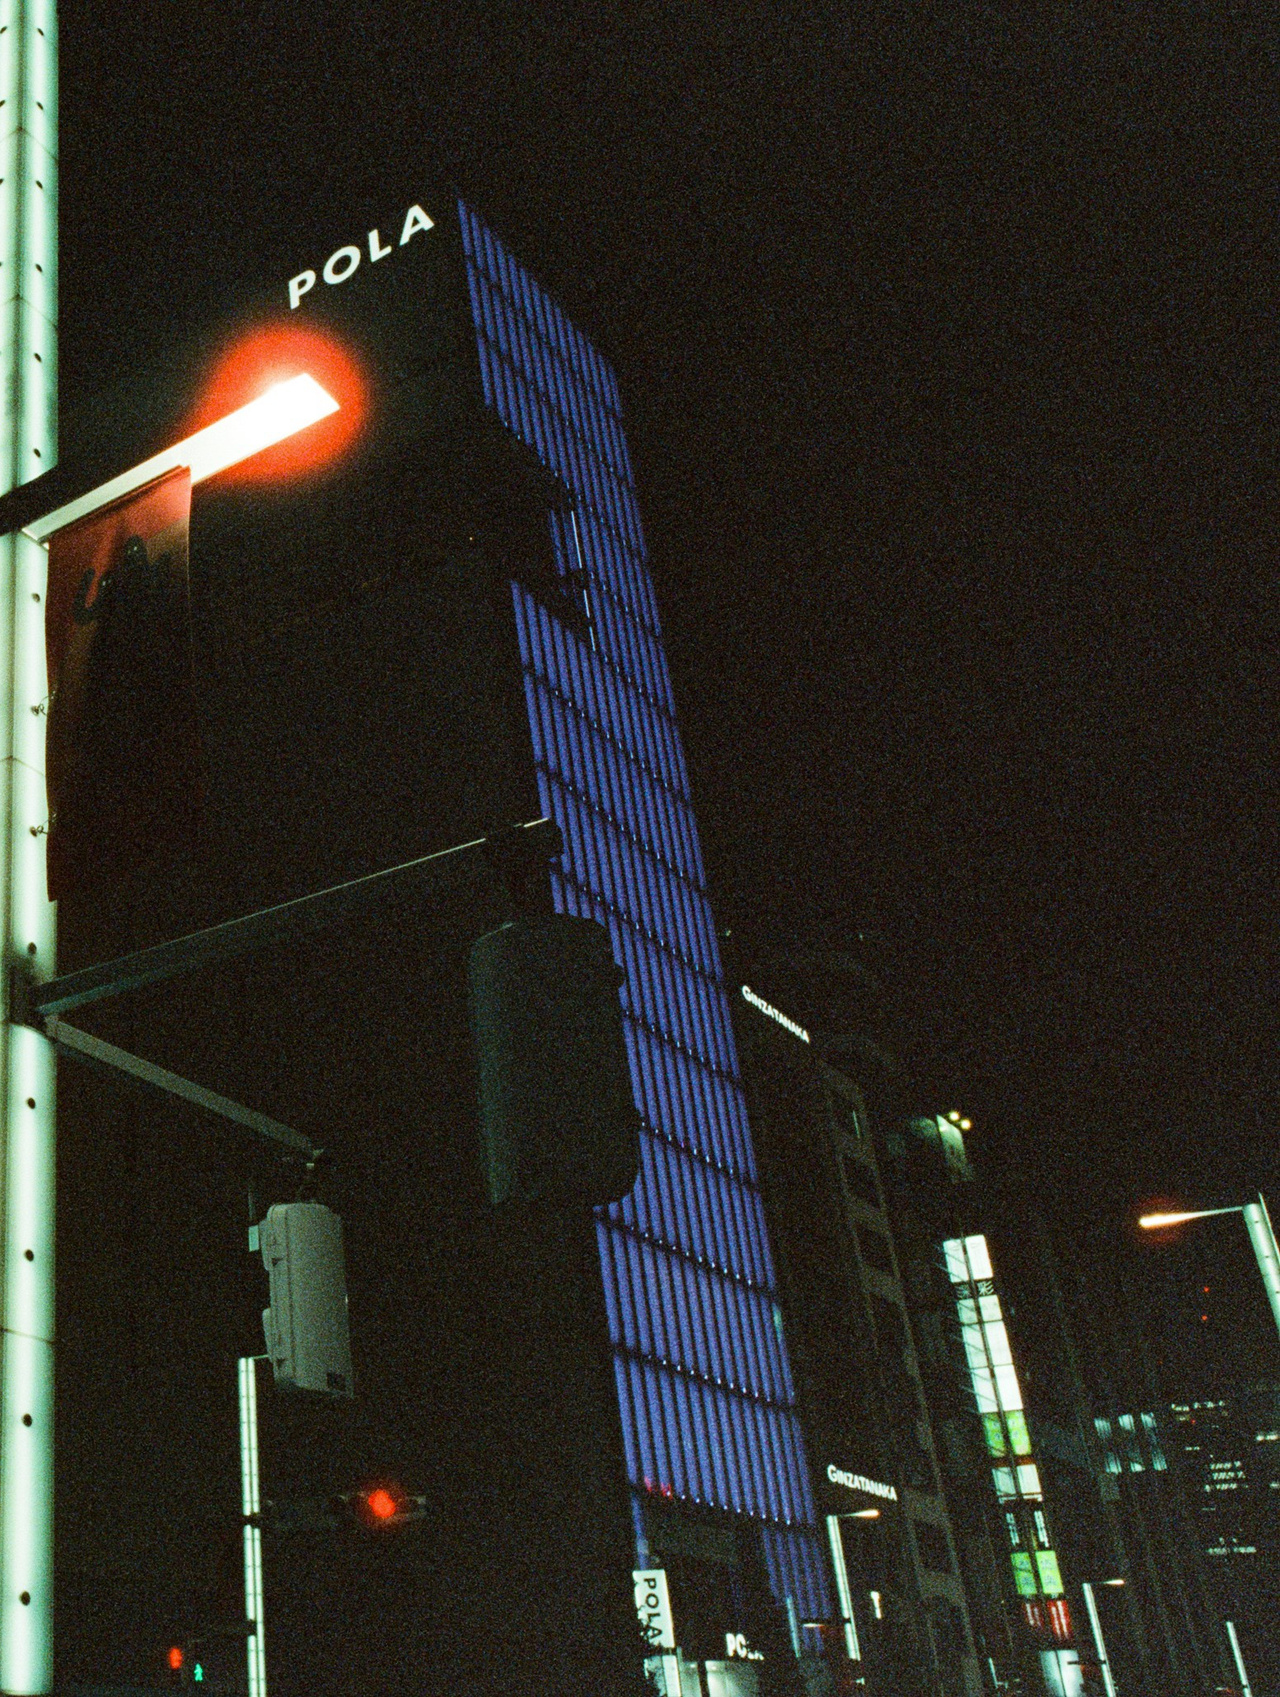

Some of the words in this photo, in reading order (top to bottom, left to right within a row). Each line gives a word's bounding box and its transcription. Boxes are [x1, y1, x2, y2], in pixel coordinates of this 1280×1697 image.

[288, 204, 435, 310] POLA
[827, 1464, 898, 1501] GINZATANAKA
[643, 1577, 662, 1640] POLA
